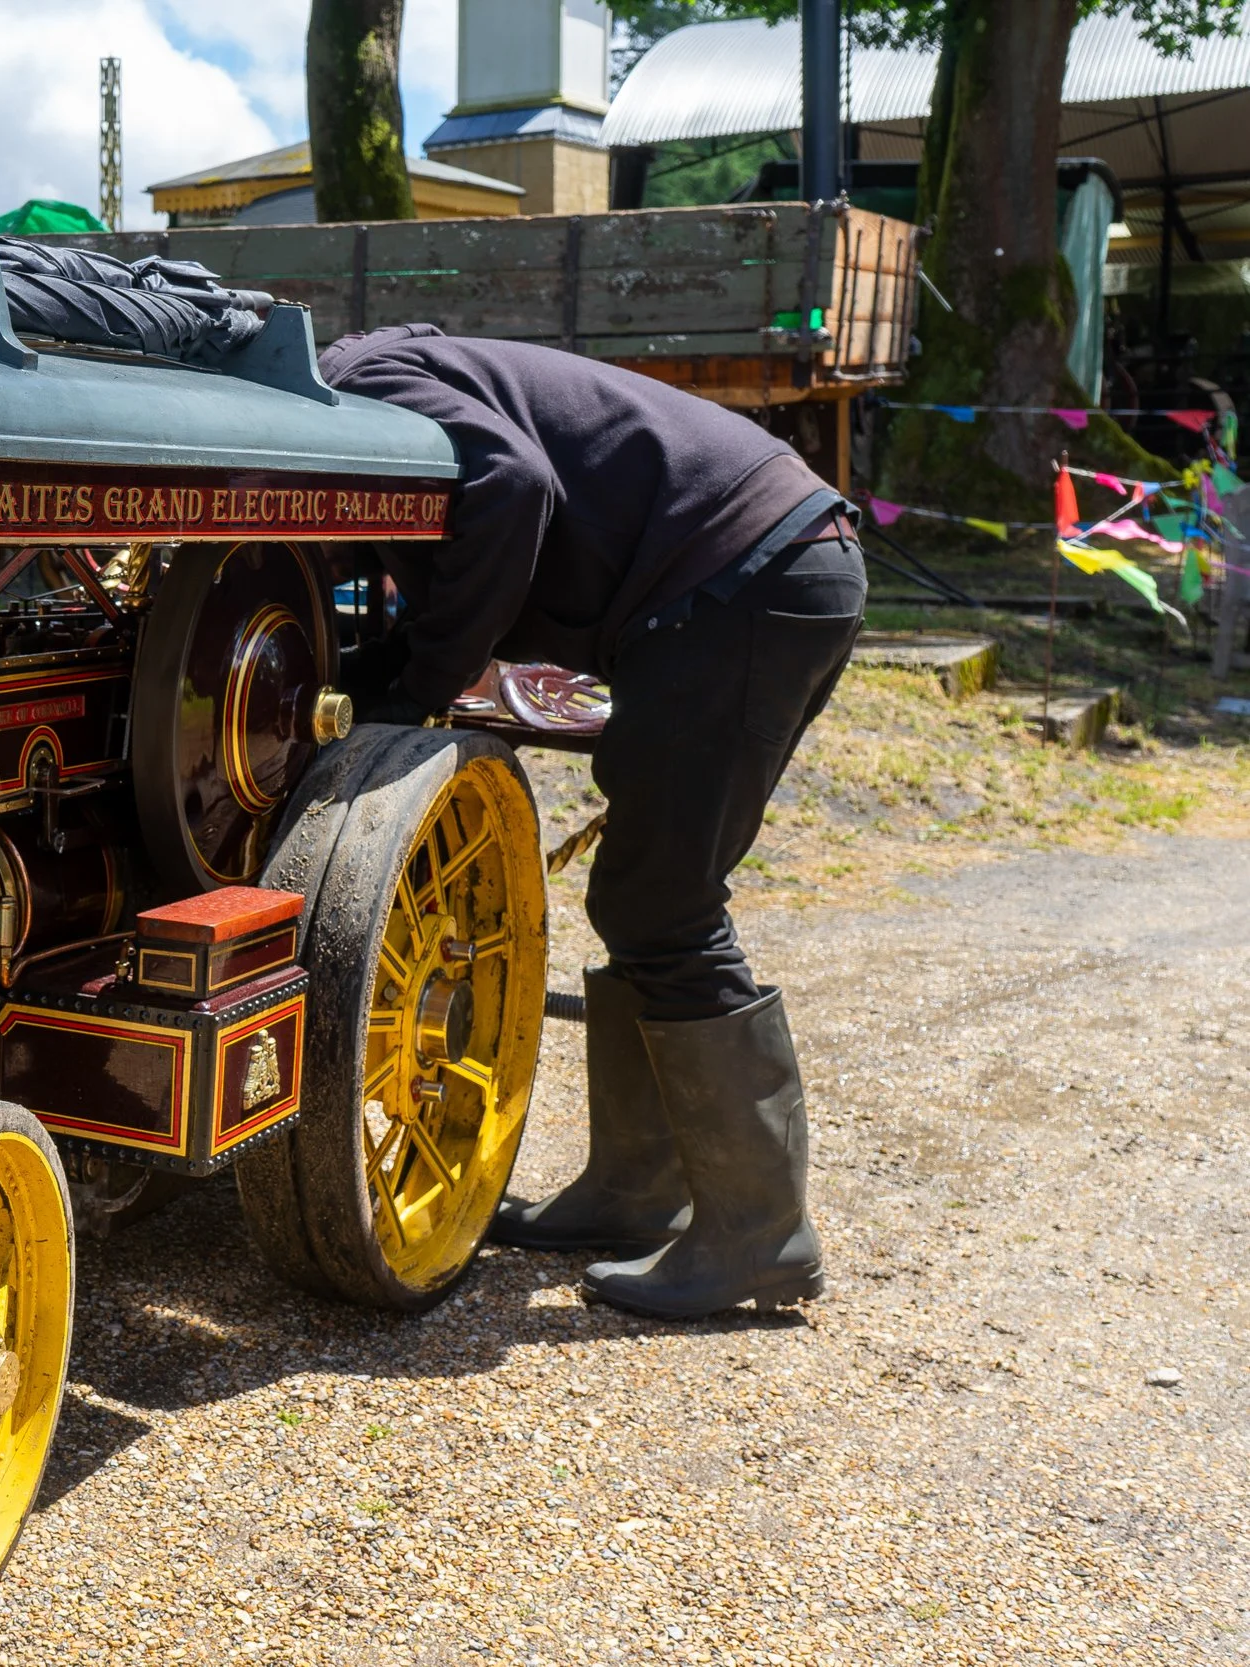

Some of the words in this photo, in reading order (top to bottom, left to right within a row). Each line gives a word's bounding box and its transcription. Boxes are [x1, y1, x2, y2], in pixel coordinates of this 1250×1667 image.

[103, 487, 203, 524] GRAND
[212, 489, 327, 524] ELECTRIC
[335, 490, 415, 523] PALACE
[421, 493, 447, 523] OF
